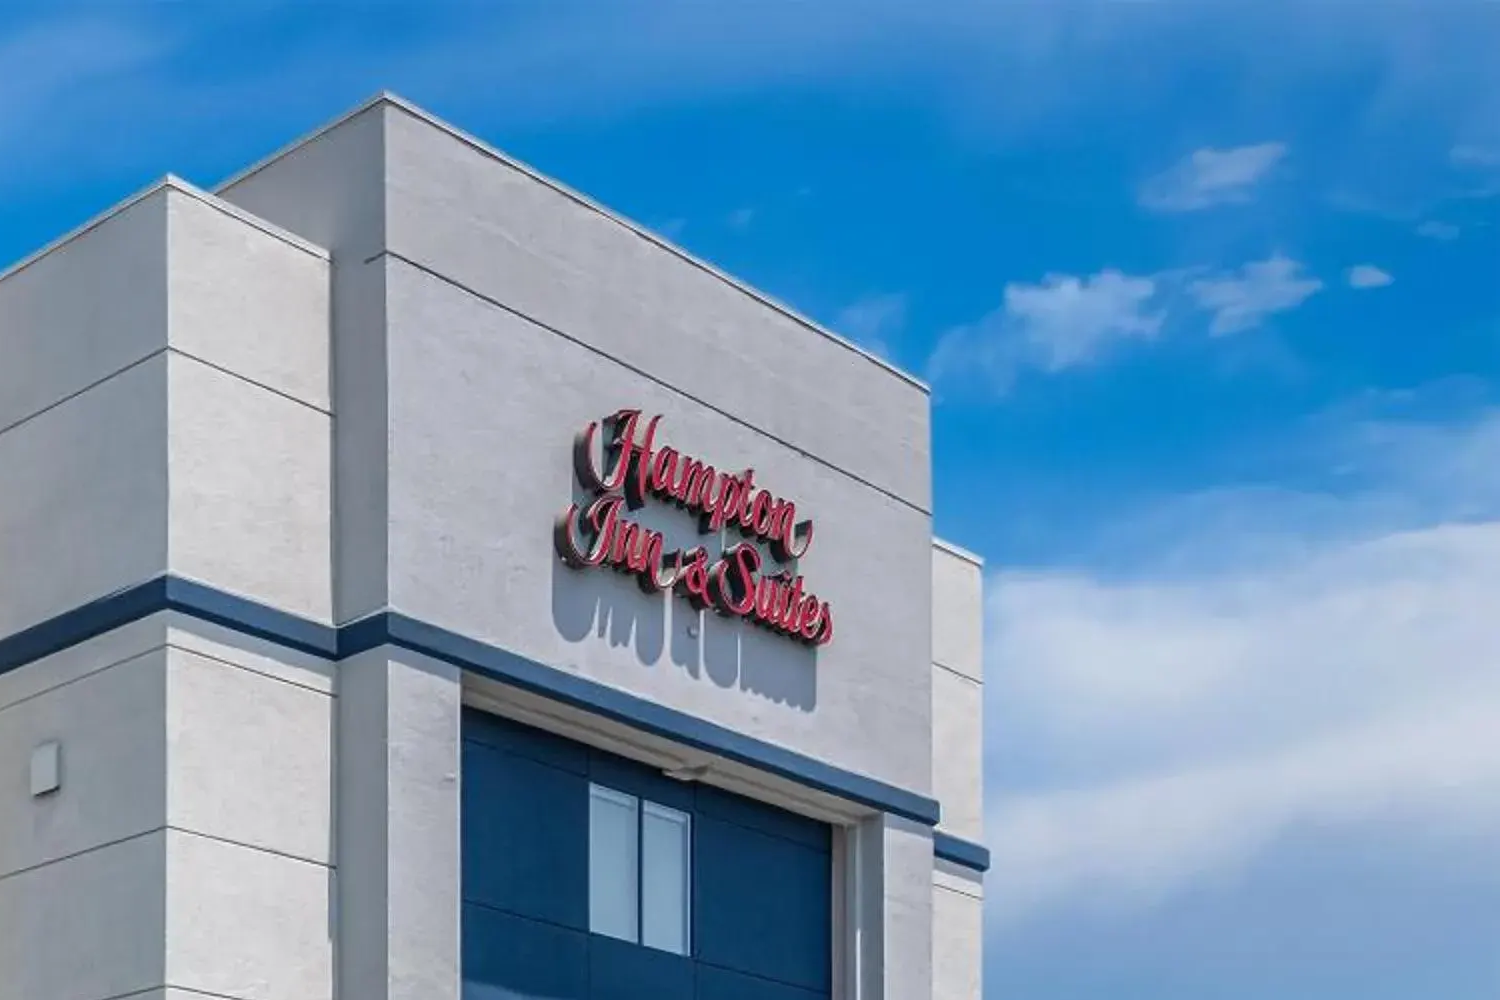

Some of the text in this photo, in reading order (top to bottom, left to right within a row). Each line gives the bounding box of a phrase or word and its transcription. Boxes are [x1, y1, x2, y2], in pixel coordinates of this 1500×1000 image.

[577, 408, 813, 559] Hampton
[558, 495, 833, 648] Inn & Suites
